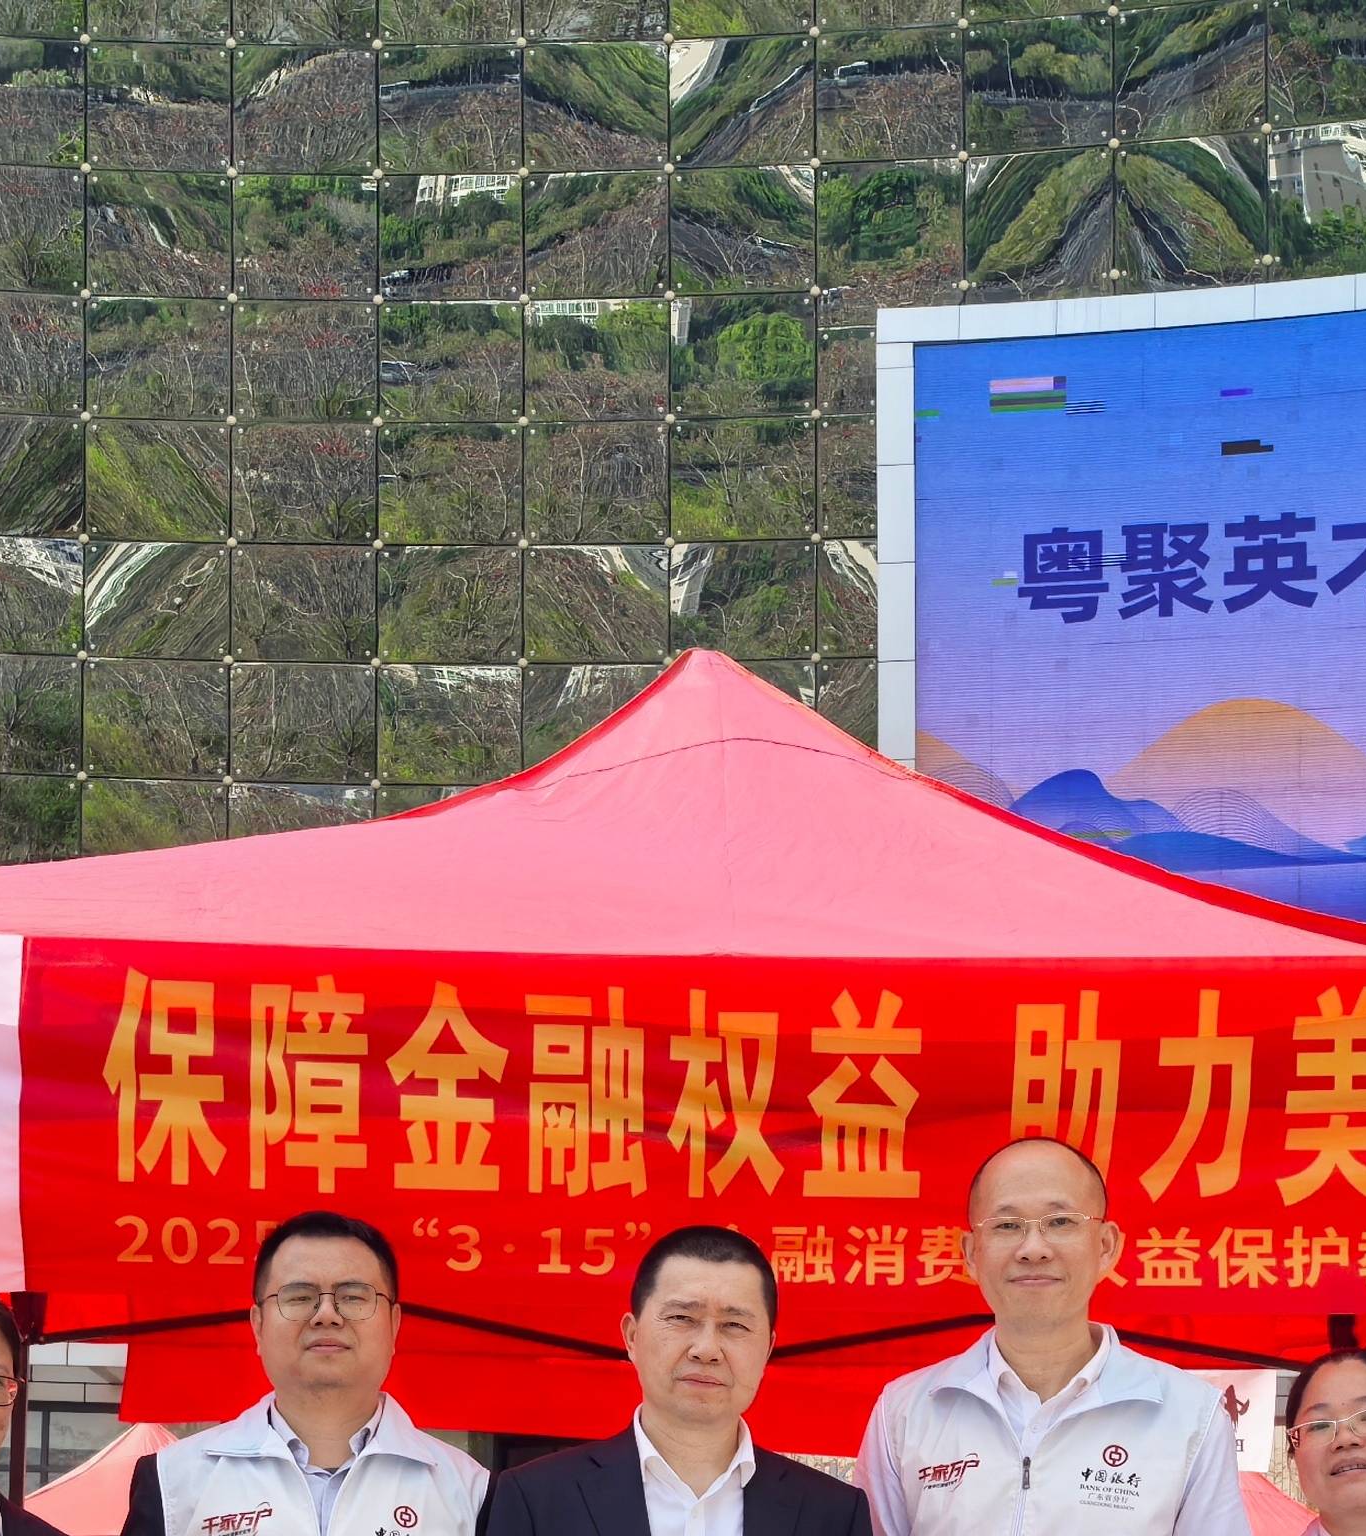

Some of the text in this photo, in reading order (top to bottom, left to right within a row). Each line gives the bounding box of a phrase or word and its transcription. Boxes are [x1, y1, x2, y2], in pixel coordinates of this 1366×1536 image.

[103, 967, 924, 1199] 保障金融权益
[1115, 1488, 1139, 1497] CHINA
